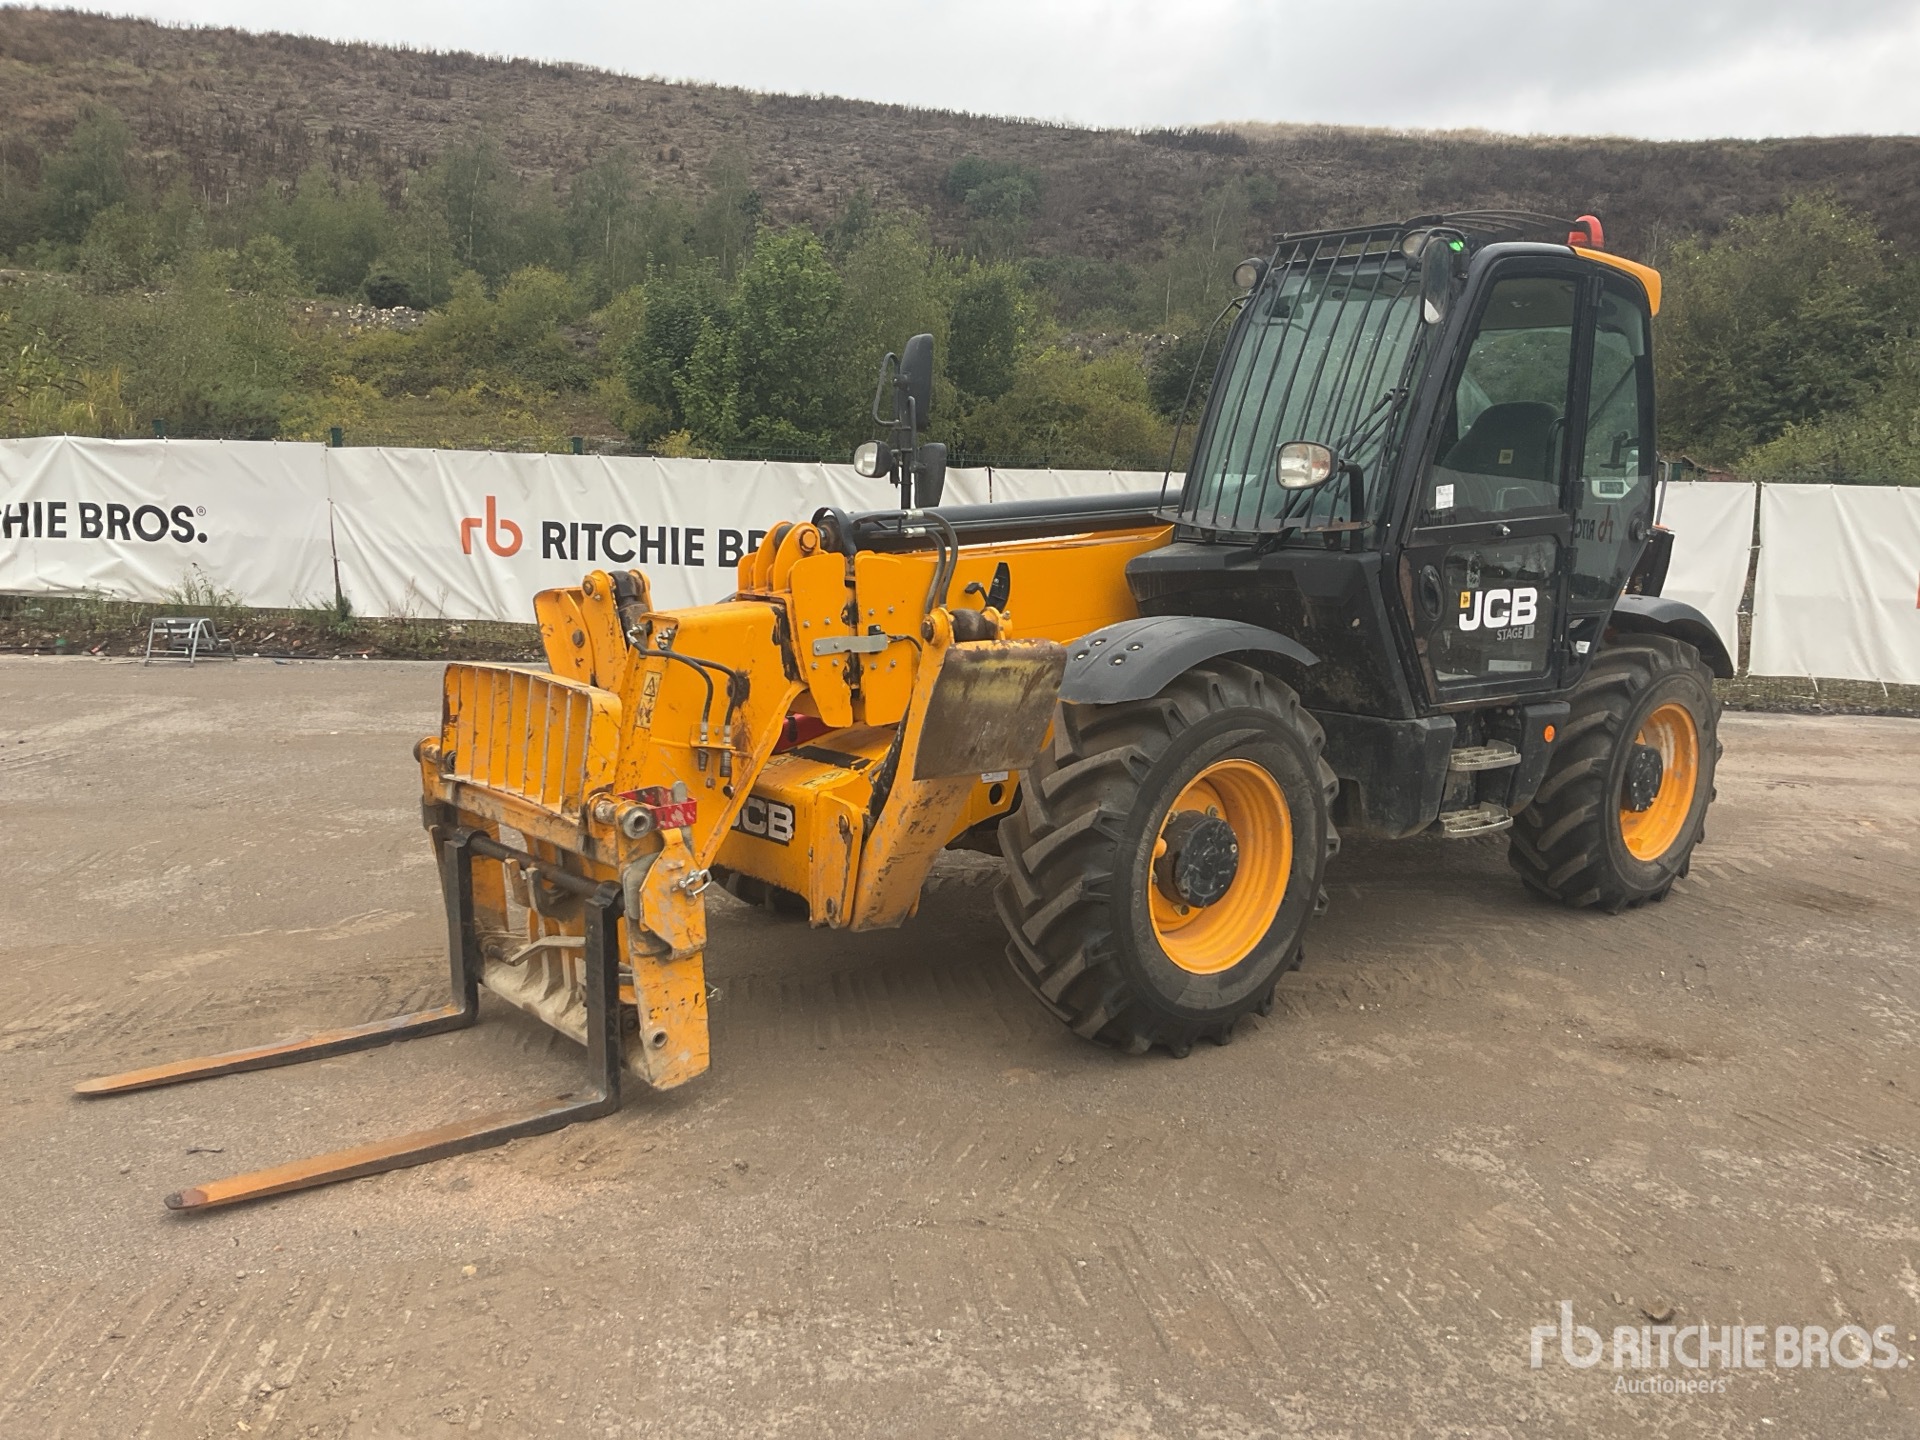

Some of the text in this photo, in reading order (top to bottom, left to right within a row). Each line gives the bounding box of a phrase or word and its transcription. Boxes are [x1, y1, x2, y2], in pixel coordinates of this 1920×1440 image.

[0, 502, 67, 538] HIE
[461, 496, 523, 557] rb
[542, 521, 704, 567] RITCHIE
[1459, 587, 1538, 631] JCB
[1497, 627, 1523, 641] STAGE
[733, 797, 793, 842] CB
